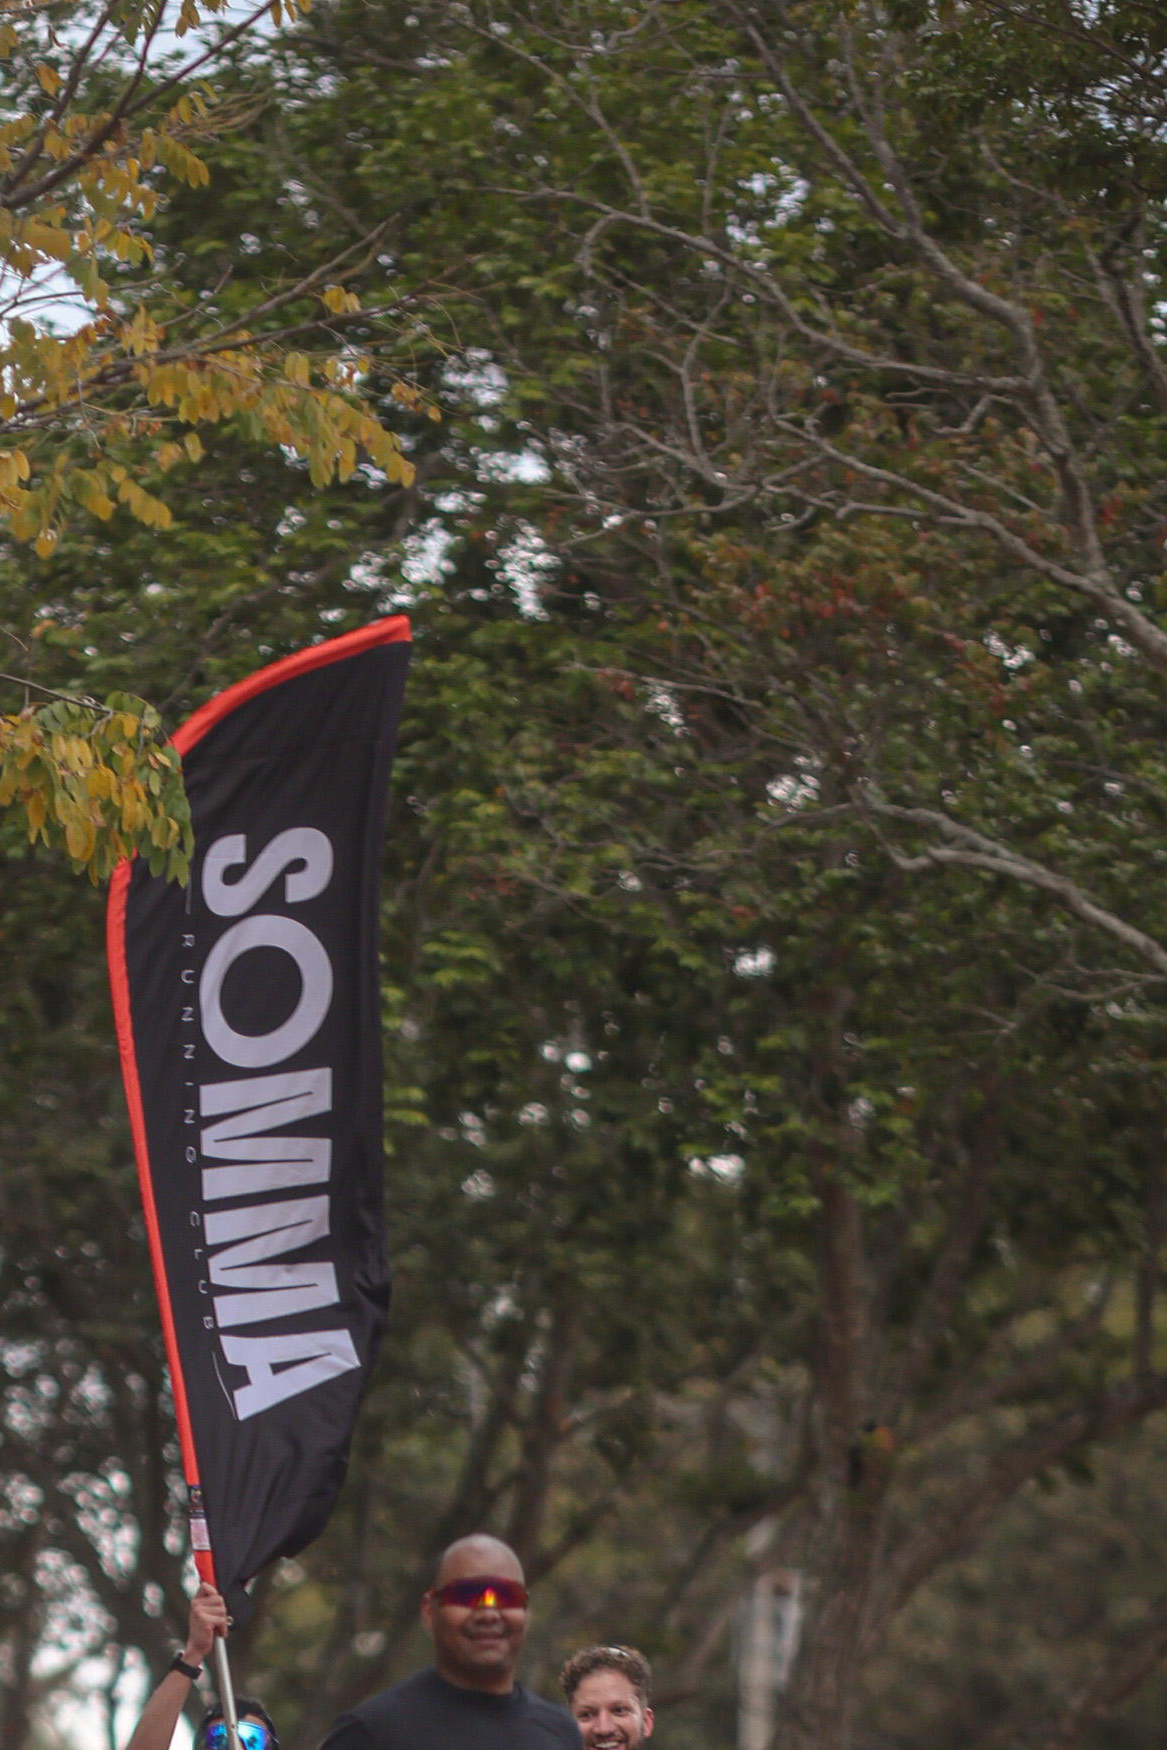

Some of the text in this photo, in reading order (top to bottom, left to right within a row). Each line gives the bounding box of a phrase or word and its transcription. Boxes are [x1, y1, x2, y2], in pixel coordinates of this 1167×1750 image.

[181, 933, 214, 1330] RUNNING CLUB
[199, 826, 361, 1421] SOMMA
